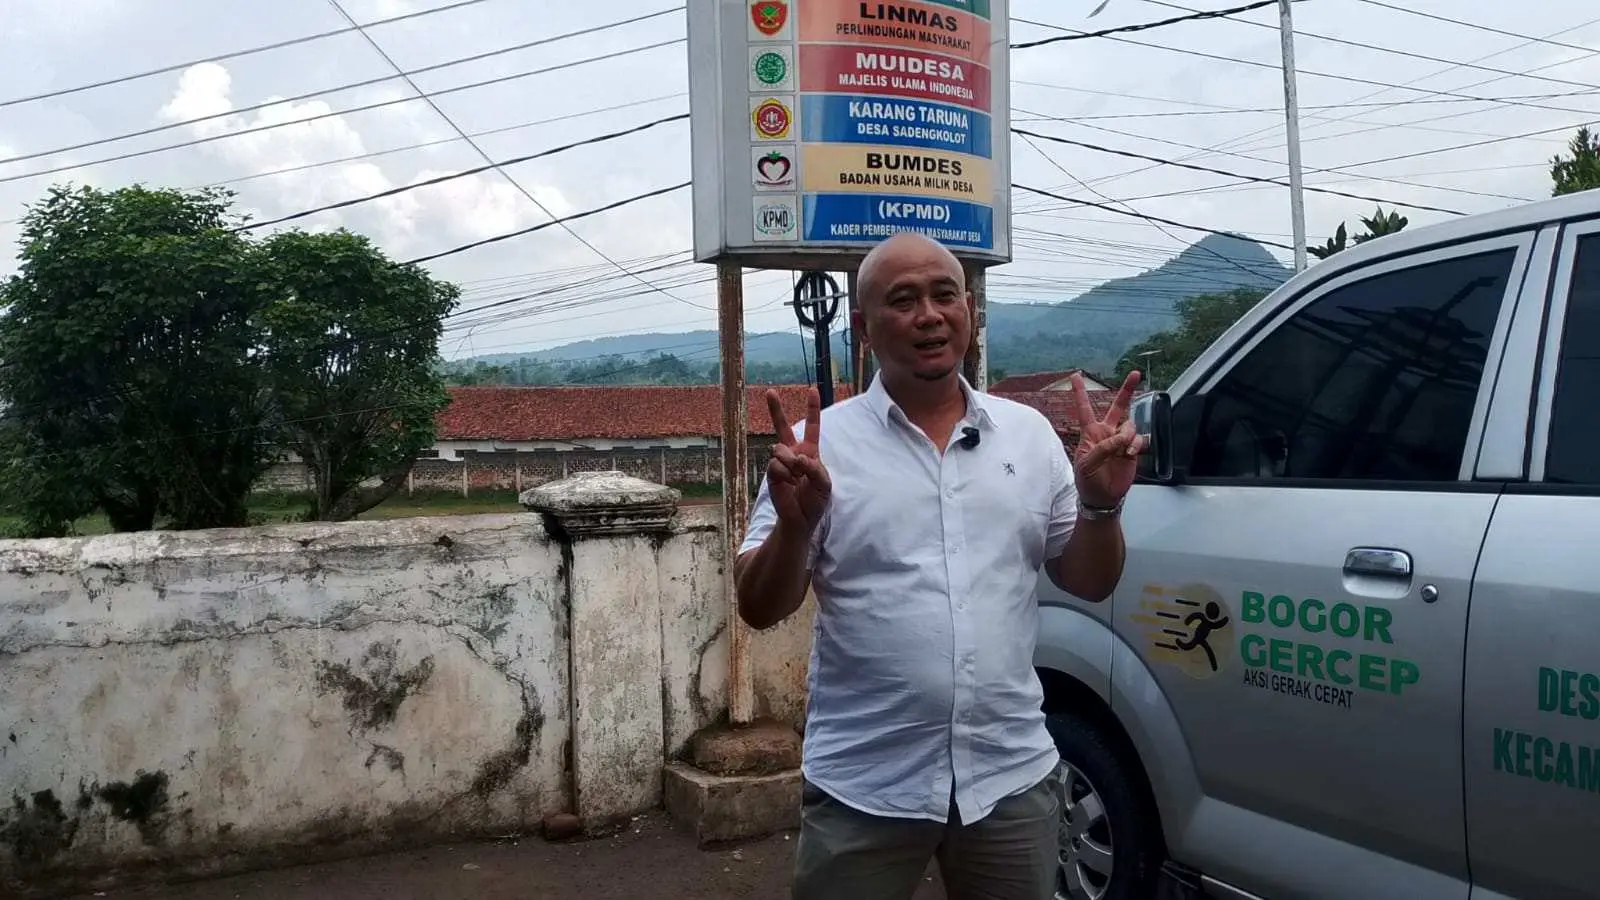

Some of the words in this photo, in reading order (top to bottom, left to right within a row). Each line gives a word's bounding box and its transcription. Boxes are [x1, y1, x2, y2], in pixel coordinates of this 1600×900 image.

[860, 3, 957, 32] LINMAS
[836, 23, 916, 41] PERLINDUNGAN
[918, 31, 971, 51] MASYARAKAT
[856, 52, 964, 81] MUIDESA
[839, 73, 888, 88] MAJELIS
[891, 77, 926, 91] ULAMA
[929, 82, 973, 100] INDONESIA
[849, 101, 915, 122] KARANG
[918, 106, 969, 129] TARUNA
[857, 122, 889, 135] DESA
[892, 125, 966, 145] SADENGKOLOT
[866, 153, 962, 176] BUMDES
[839, 172, 880, 185] BADAN
[884, 174, 921, 188] USAHA
[924, 176, 950, 190] MILIK
[953, 180, 974, 194] DESA
[763, 210, 788, 228] KPMD
[878, 200, 950, 223] (KPMD)
[831, 223, 860, 236] KADER
[927, 227, 967, 241] MASYARAKAT
[968, 231, 981, 242] DESA
[1241, 590, 1394, 644] BOGOR
[1240, 633, 1420, 696] GERCEP
[1243, 669, 1269, 690] AKSI
[1271, 674, 1312, 699] GERAK
[1314, 684, 1354, 708] CEPAT
